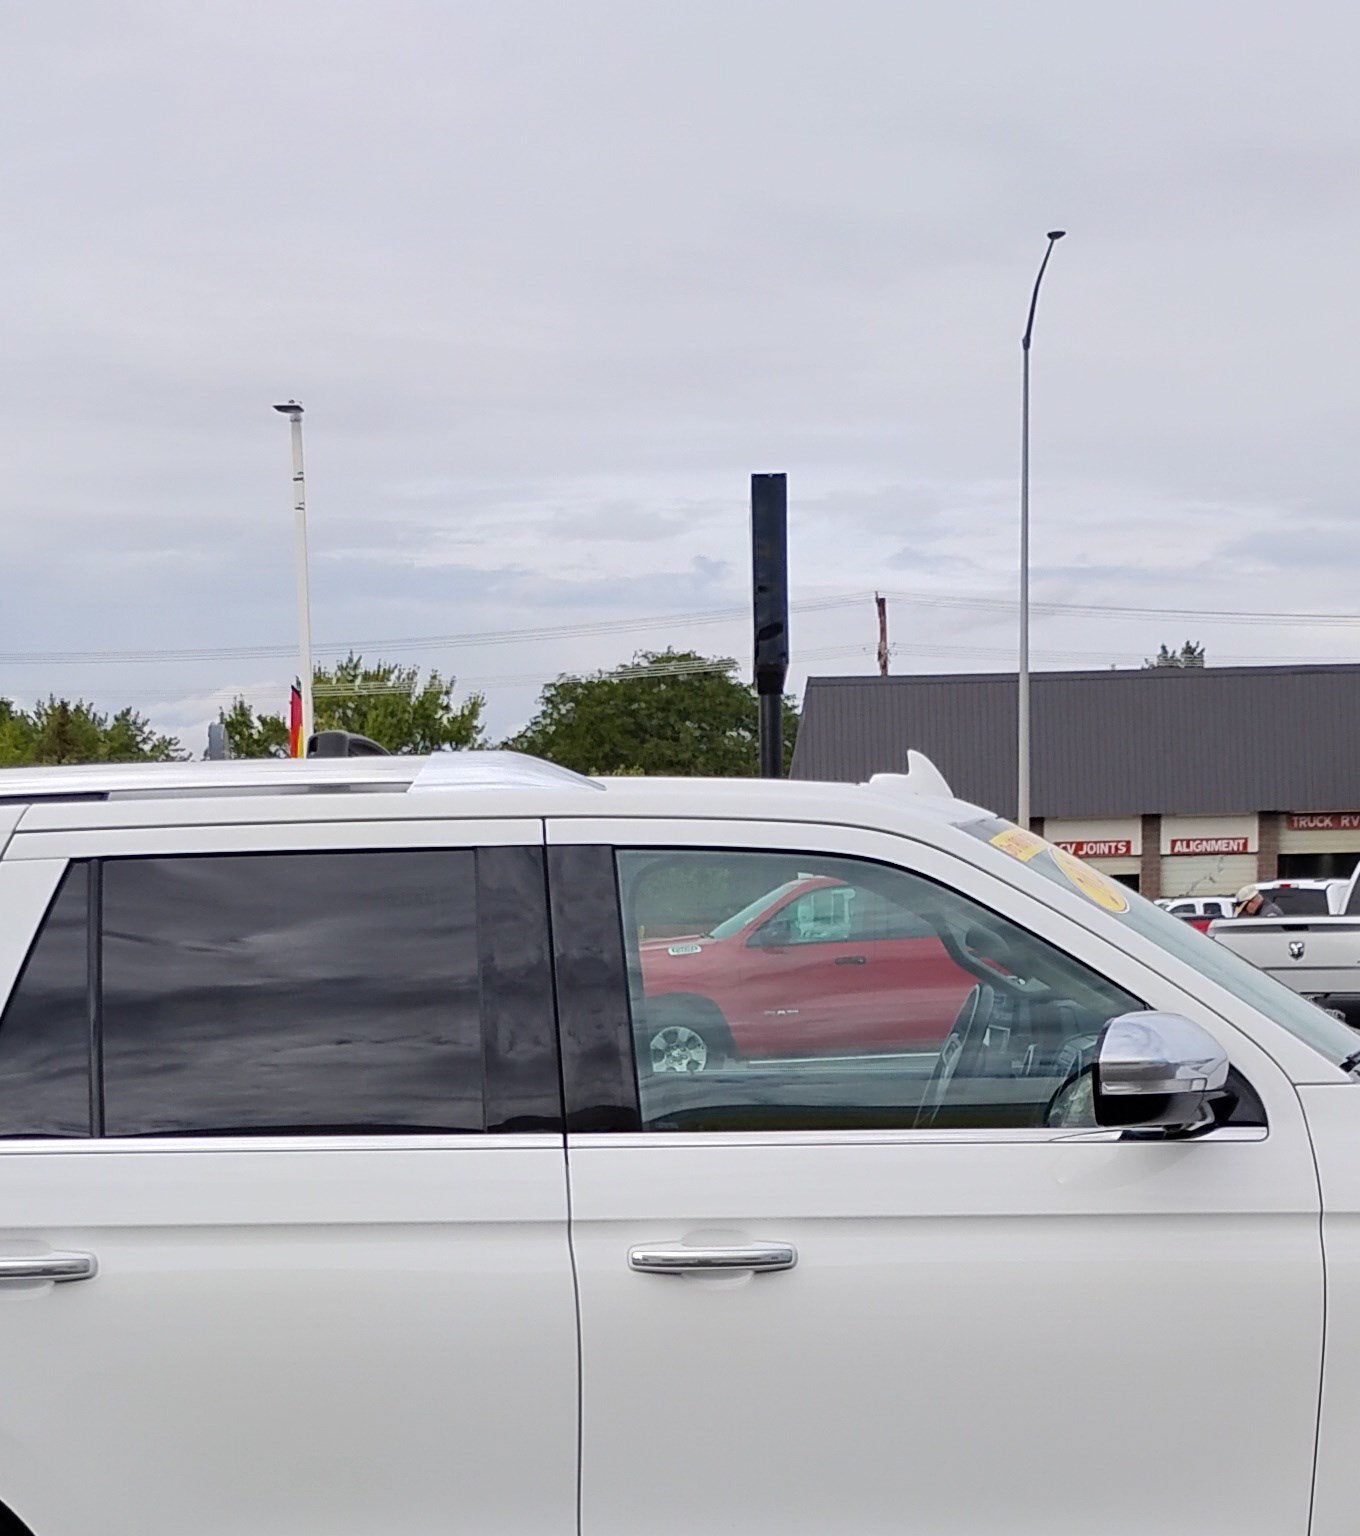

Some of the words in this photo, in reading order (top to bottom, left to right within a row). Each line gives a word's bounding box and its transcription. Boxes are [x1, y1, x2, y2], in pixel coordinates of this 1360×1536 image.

[1292, 815, 1333, 828] TRUCK
[1340, 815, 1360, 827] RV
[1078, 841, 1127, 855] JOINTS
[1173, 839, 1246, 853] ALIGNMENT
